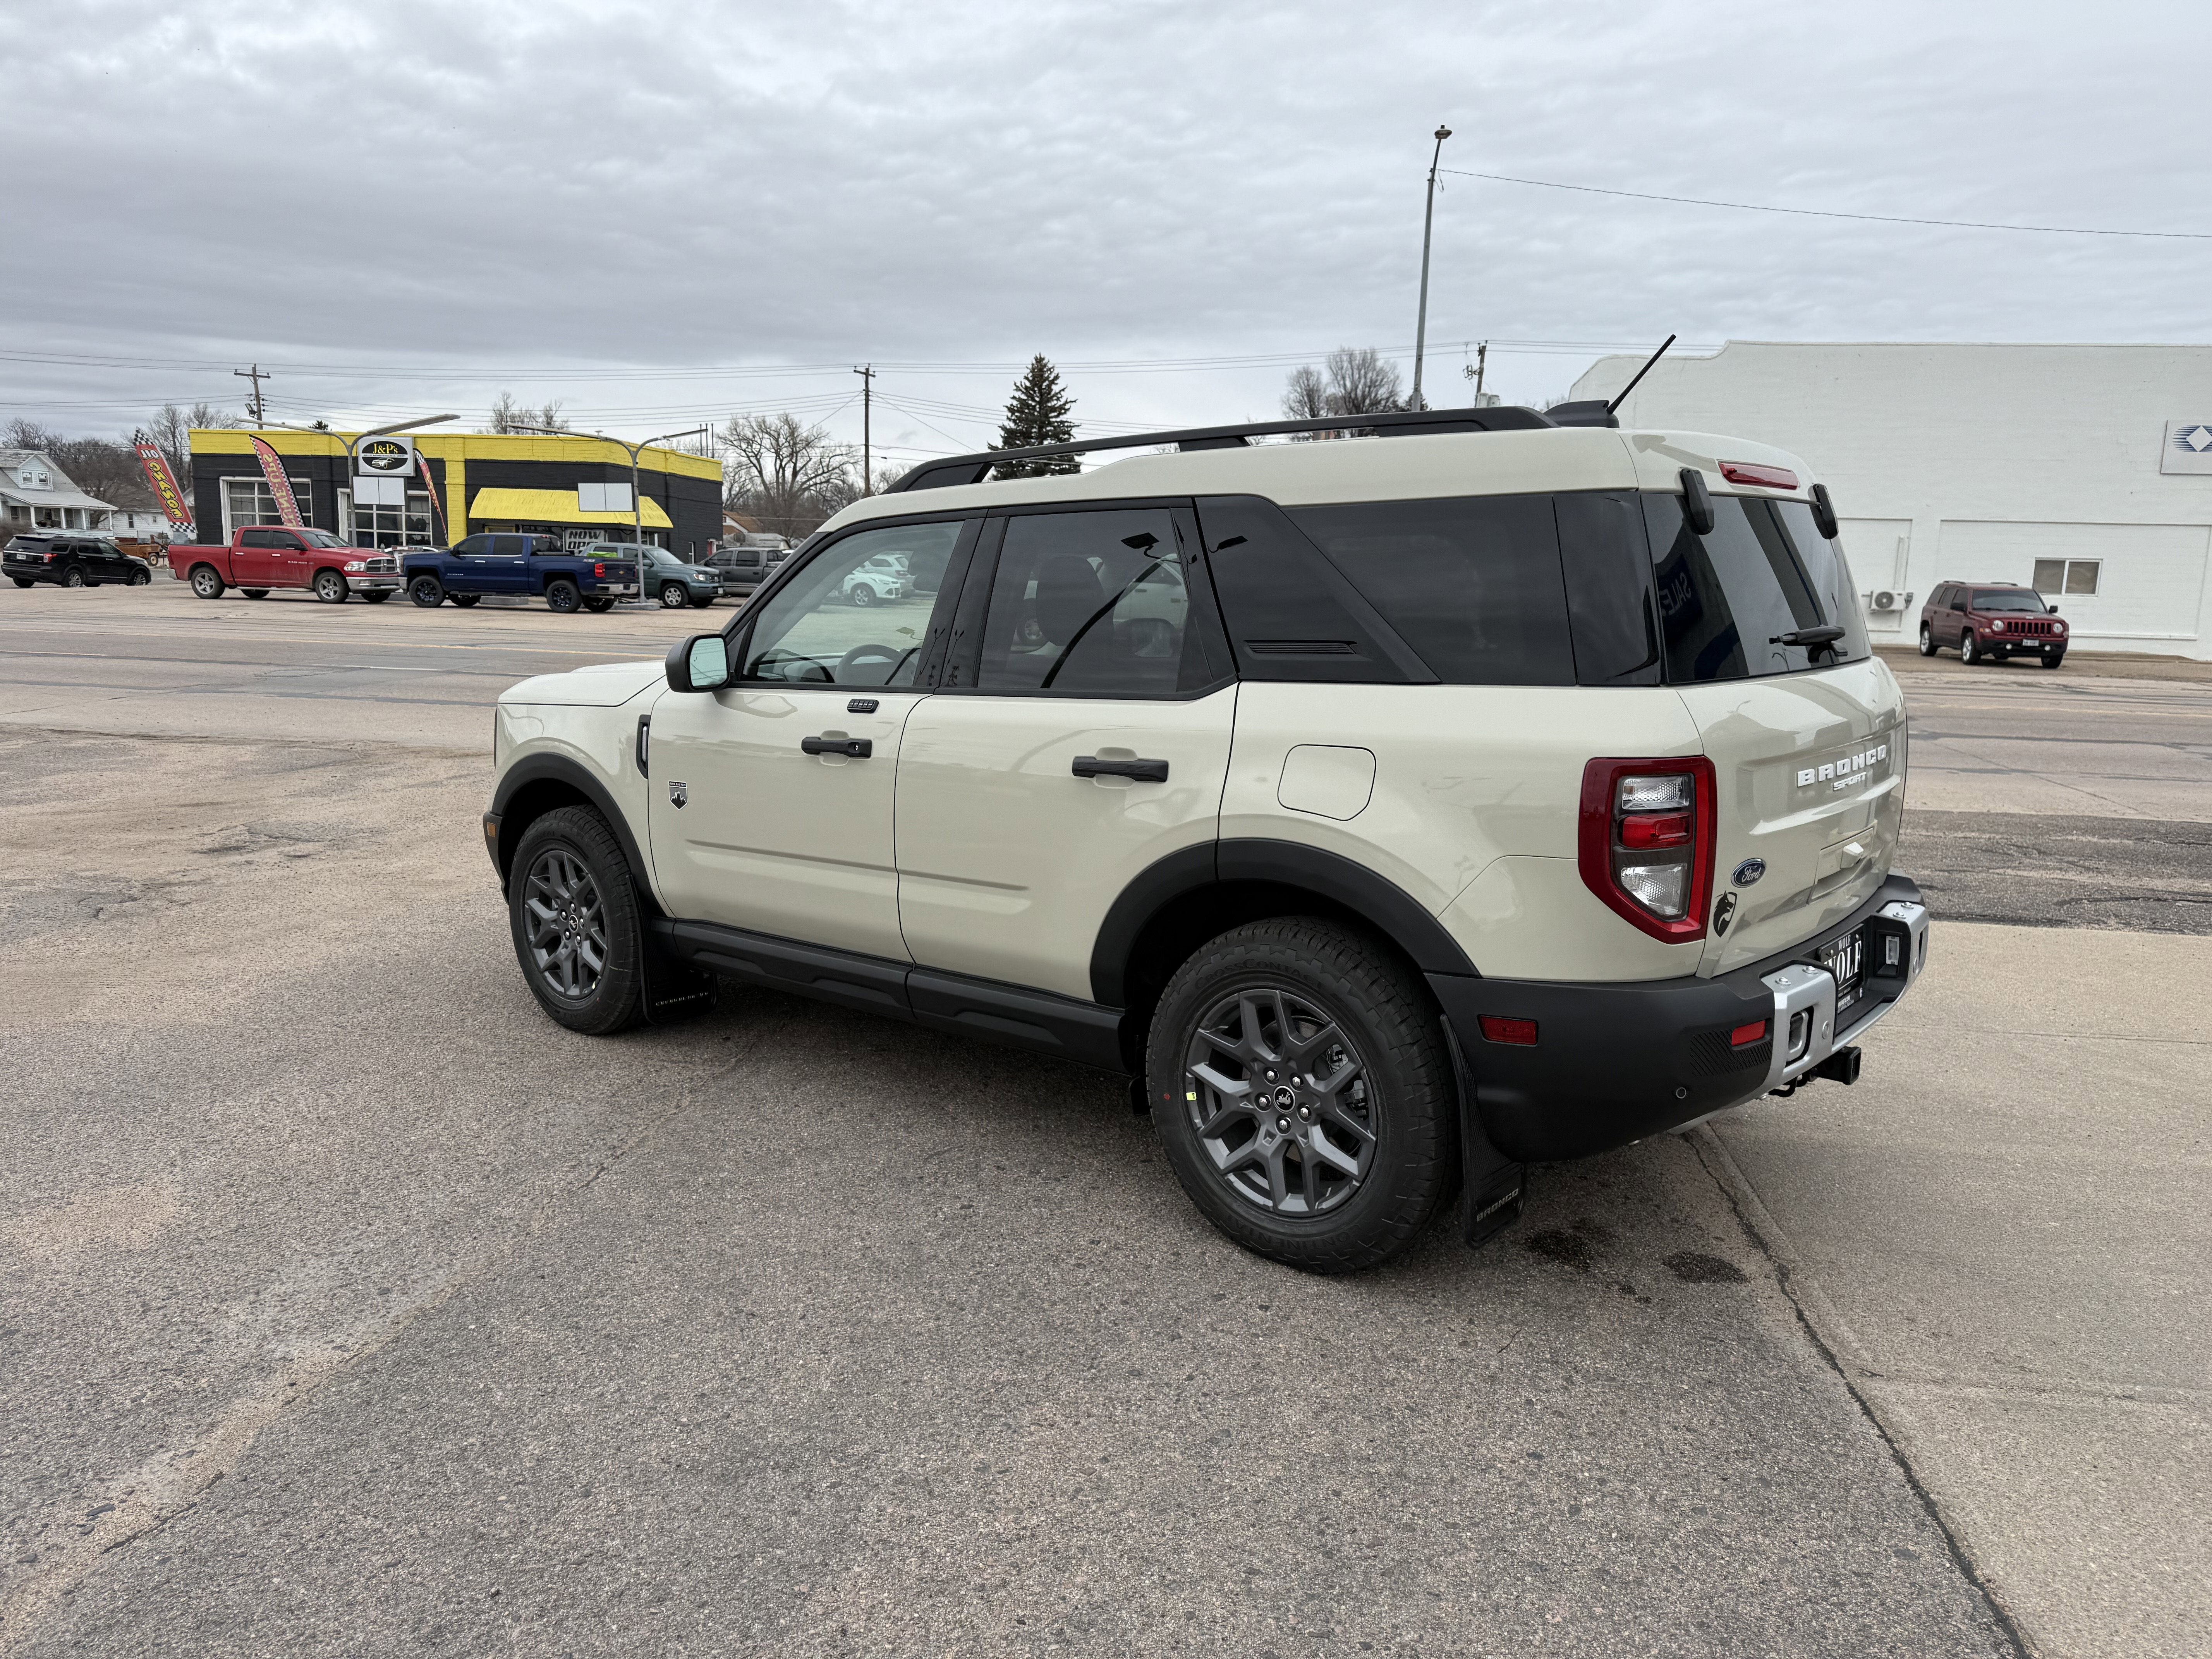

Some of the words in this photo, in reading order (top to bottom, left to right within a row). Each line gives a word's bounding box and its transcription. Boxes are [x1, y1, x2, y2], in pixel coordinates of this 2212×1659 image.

[373, 443, 398, 454] J&P's
[568, 531, 601, 539] NOW
[1796, 745, 1887, 787] BRONCO
[1833, 772, 1867, 791] SPORT
[1741, 866, 1761, 883] Ford
[1838, 934, 1851, 951] WOLF
[1476, 1188, 1519, 1222] BRONCO
